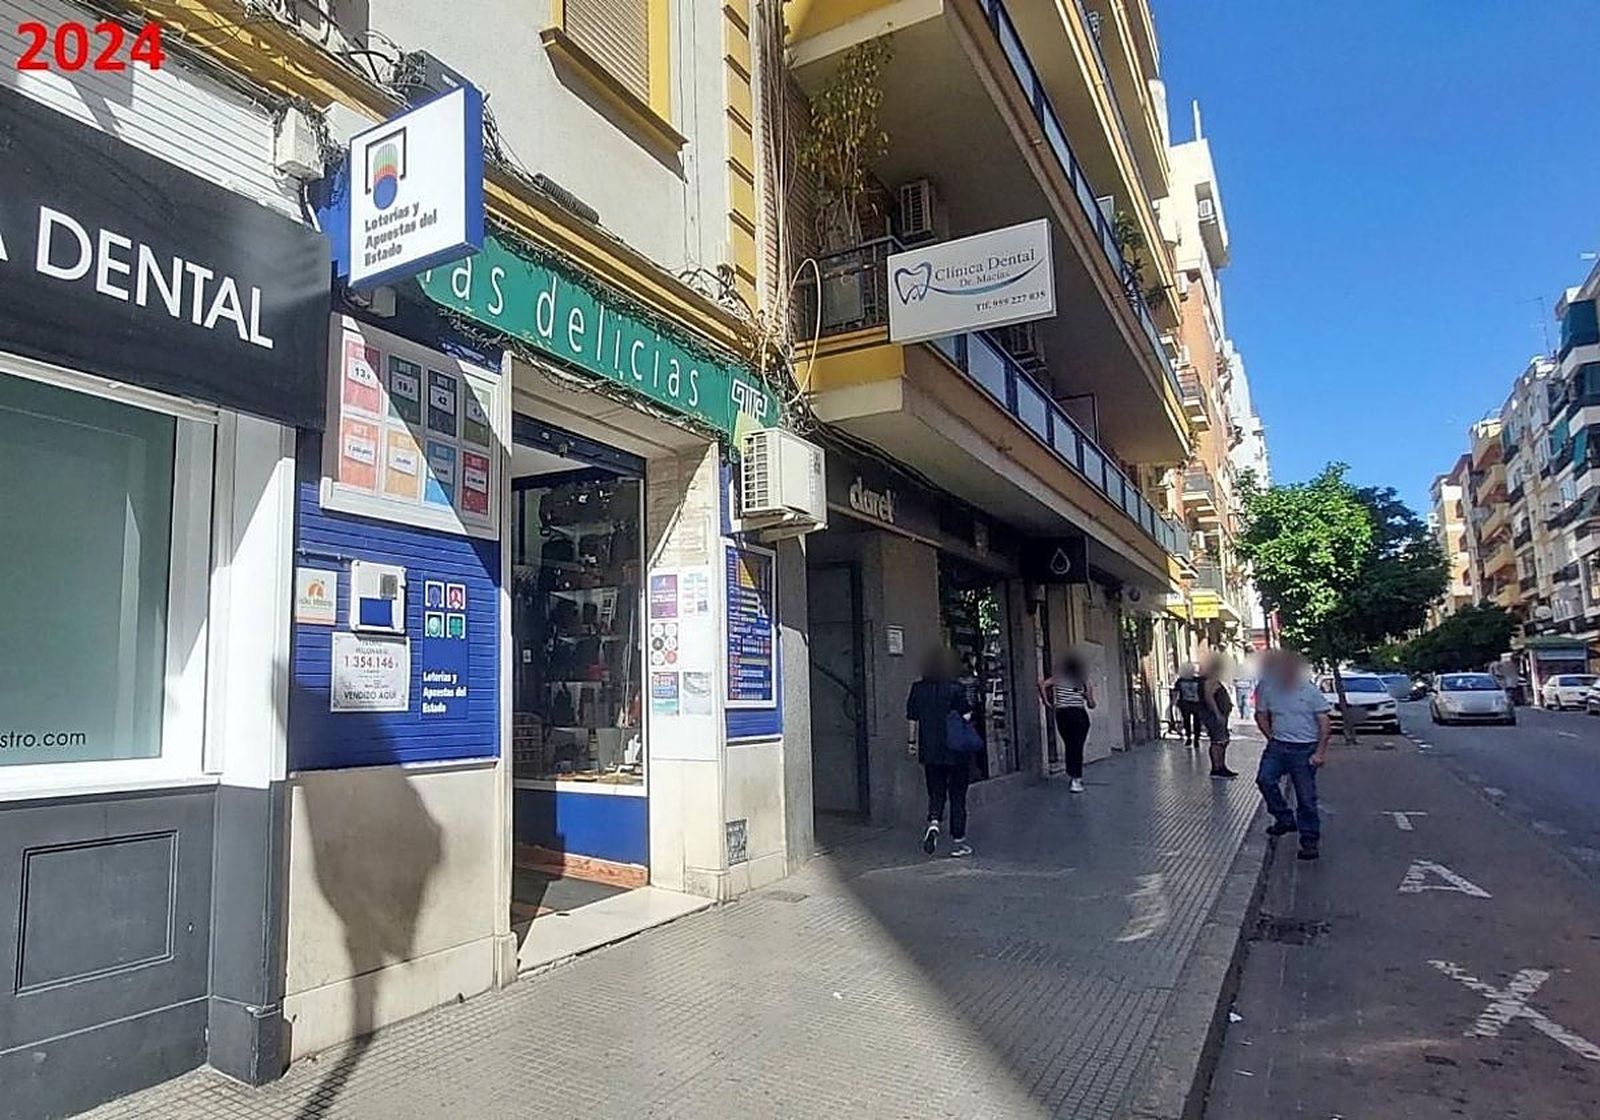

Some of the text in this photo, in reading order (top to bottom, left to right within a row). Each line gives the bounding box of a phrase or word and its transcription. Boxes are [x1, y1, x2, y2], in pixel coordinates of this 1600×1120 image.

[412, 202, 420, 218] y
[365, 208, 437, 250] Apuestas del
[364, 242, 403, 267] Estado
[988, 248, 1035, 270] Dental
[36, 206, 274, 350] DENTAL
[536, 276, 700, 408] delicias
[455, 686, 467, 697] del
[422, 702, 447, 713] Estado
